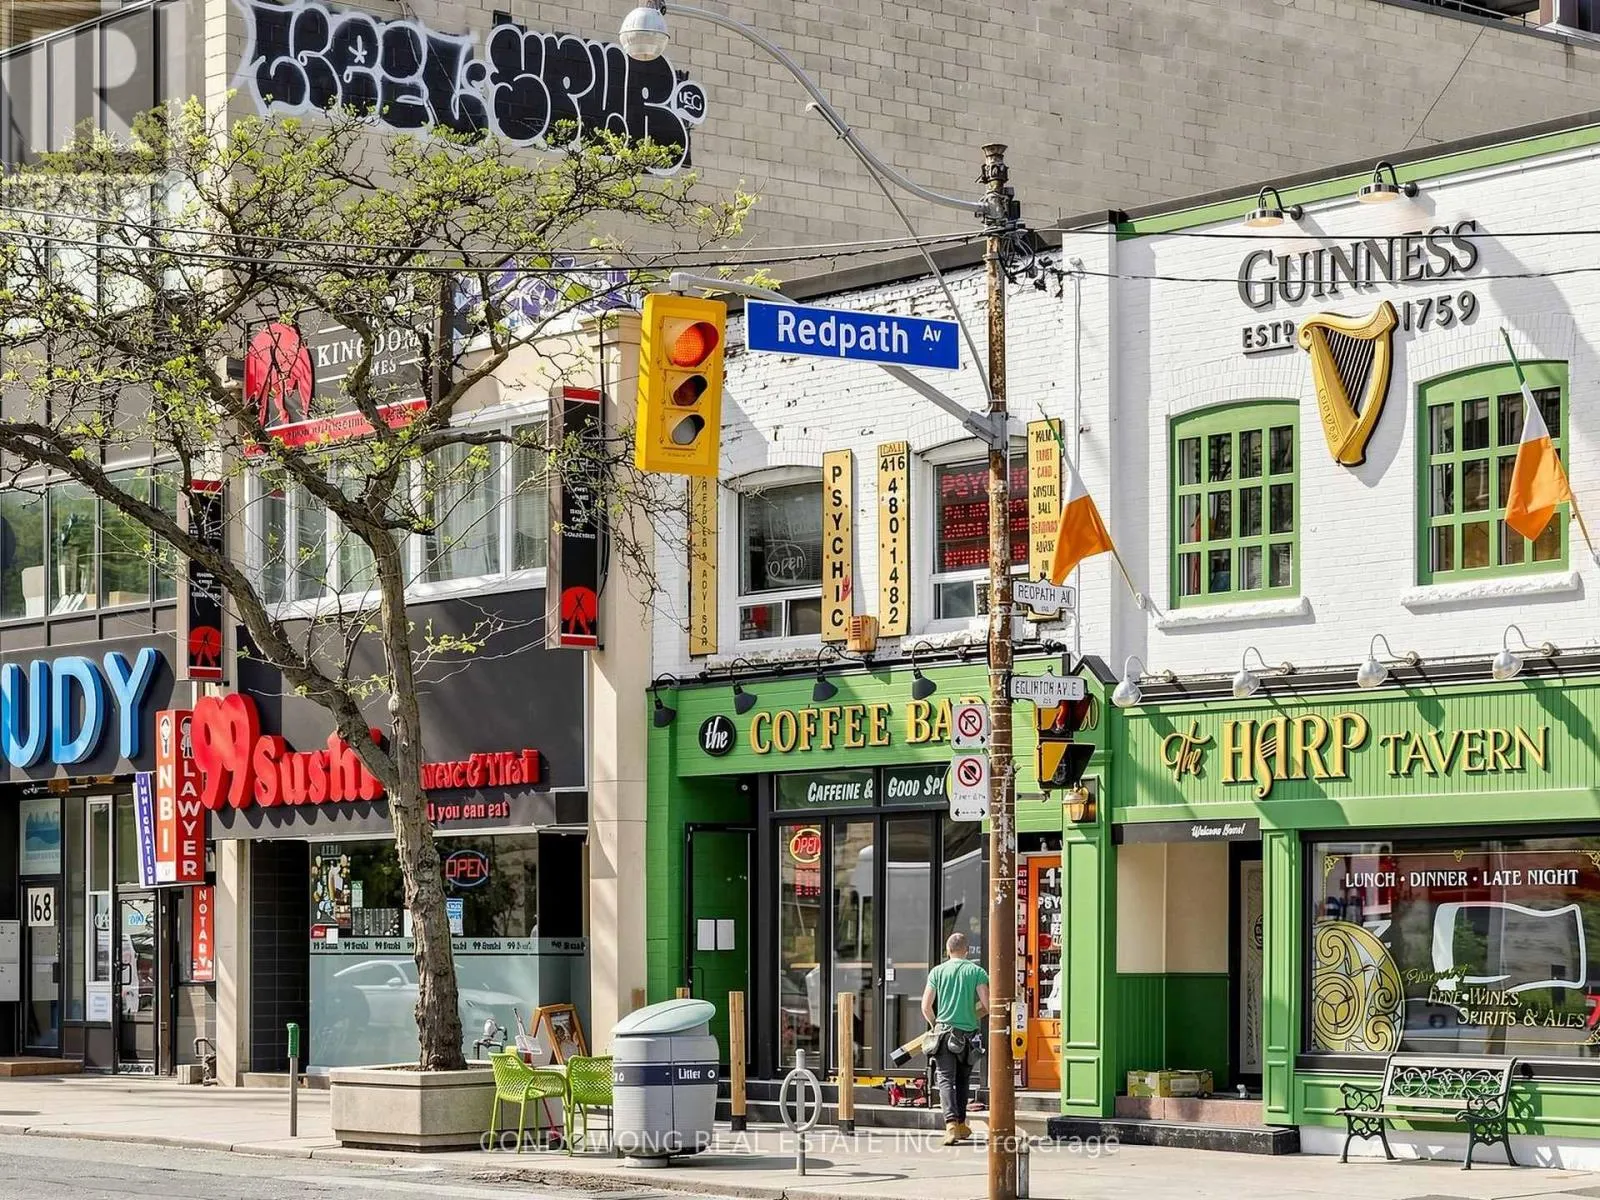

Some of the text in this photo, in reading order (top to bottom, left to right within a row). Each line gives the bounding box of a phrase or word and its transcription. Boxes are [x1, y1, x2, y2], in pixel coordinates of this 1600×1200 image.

[1238, 220, 1479, 309] GUINNESS
[1402, 289, 1478, 332] 1759
[777, 310, 942, 356] Redpath Av
[881, 455, 905, 472] 416
[831, 465, 844, 627] PSYCHIC
[1018, 584, 1056, 602] REDPATH
[705, 716, 728, 749] the
[750, 702, 892, 754] COFFEE
[191, 692, 260, 809] 99
[1161, 711, 1550, 799] The HARP TAVERN
[807, 782, 861, 802] CAFFEINE
[864, 779, 873, 799] &
[888, 777, 920, 797] GOOD
[178, 761, 201, 876] LAWYER
[438, 805, 460, 822] you
[463, 803, 486, 818] can
[488, 801, 509, 817] eat
[445, 858, 489, 880] OPEN
[1345, 868, 1579, 888] LUNCH DINNER LATE NIGHT
[30, 893, 51, 922] 168
[1457, 1007, 1517, 1026] SPIRITS
[1523, 1007, 1538, 1026] &
